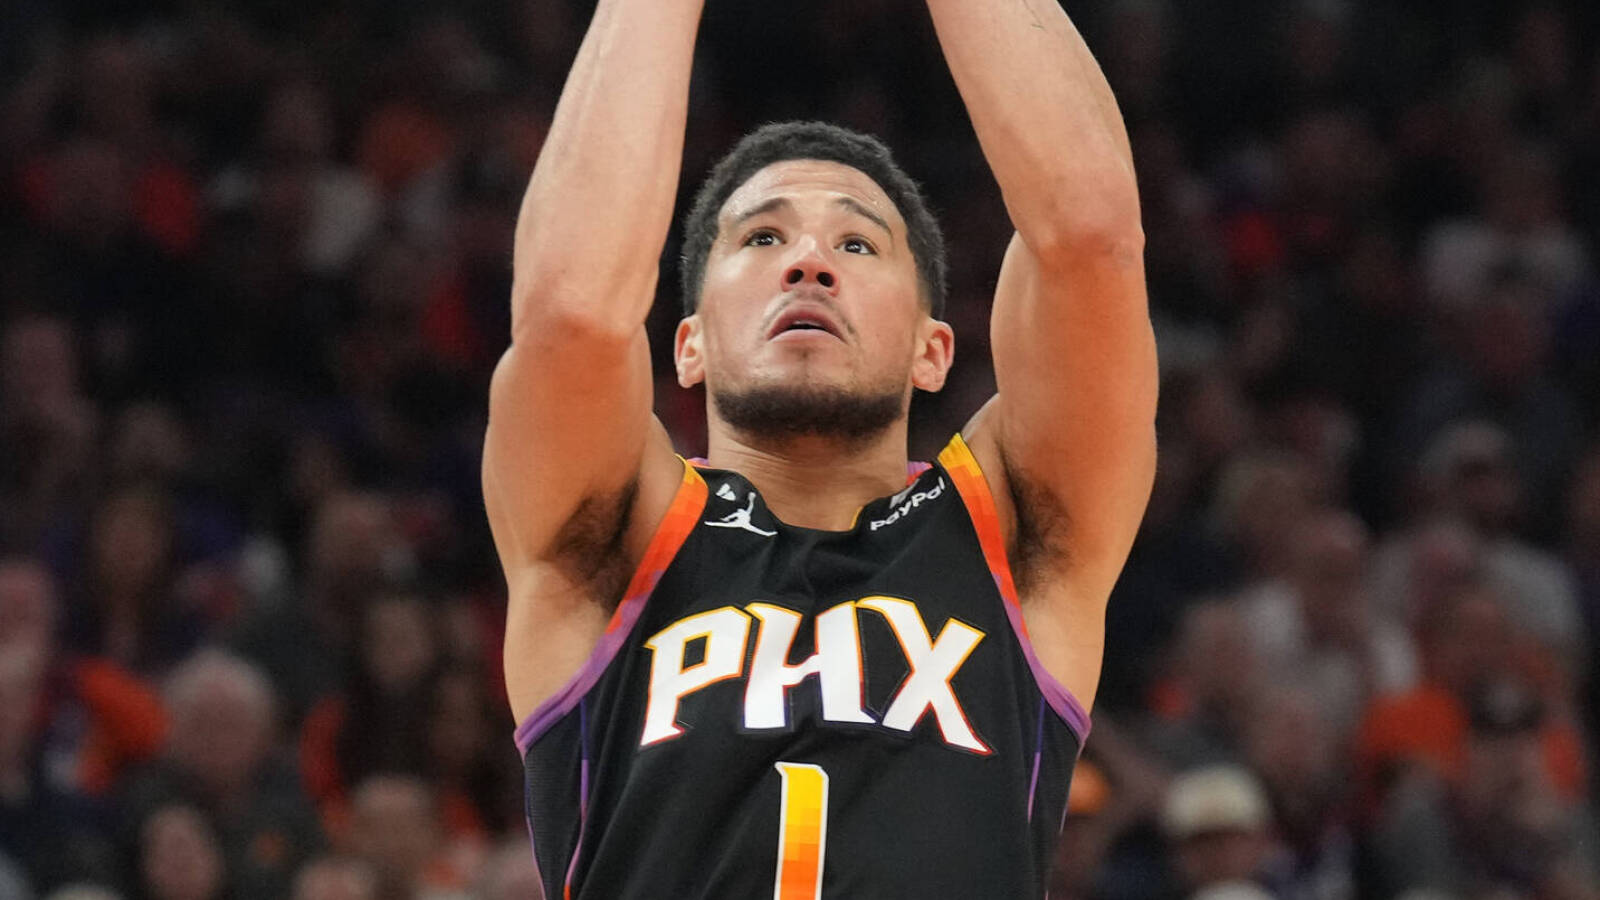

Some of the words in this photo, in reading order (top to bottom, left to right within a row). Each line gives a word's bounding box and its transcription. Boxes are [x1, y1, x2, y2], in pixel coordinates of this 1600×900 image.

[870, 475, 946, 531] PayPal
[639, 595, 993, 756] PHX
[773, 760, 830, 900] 1
